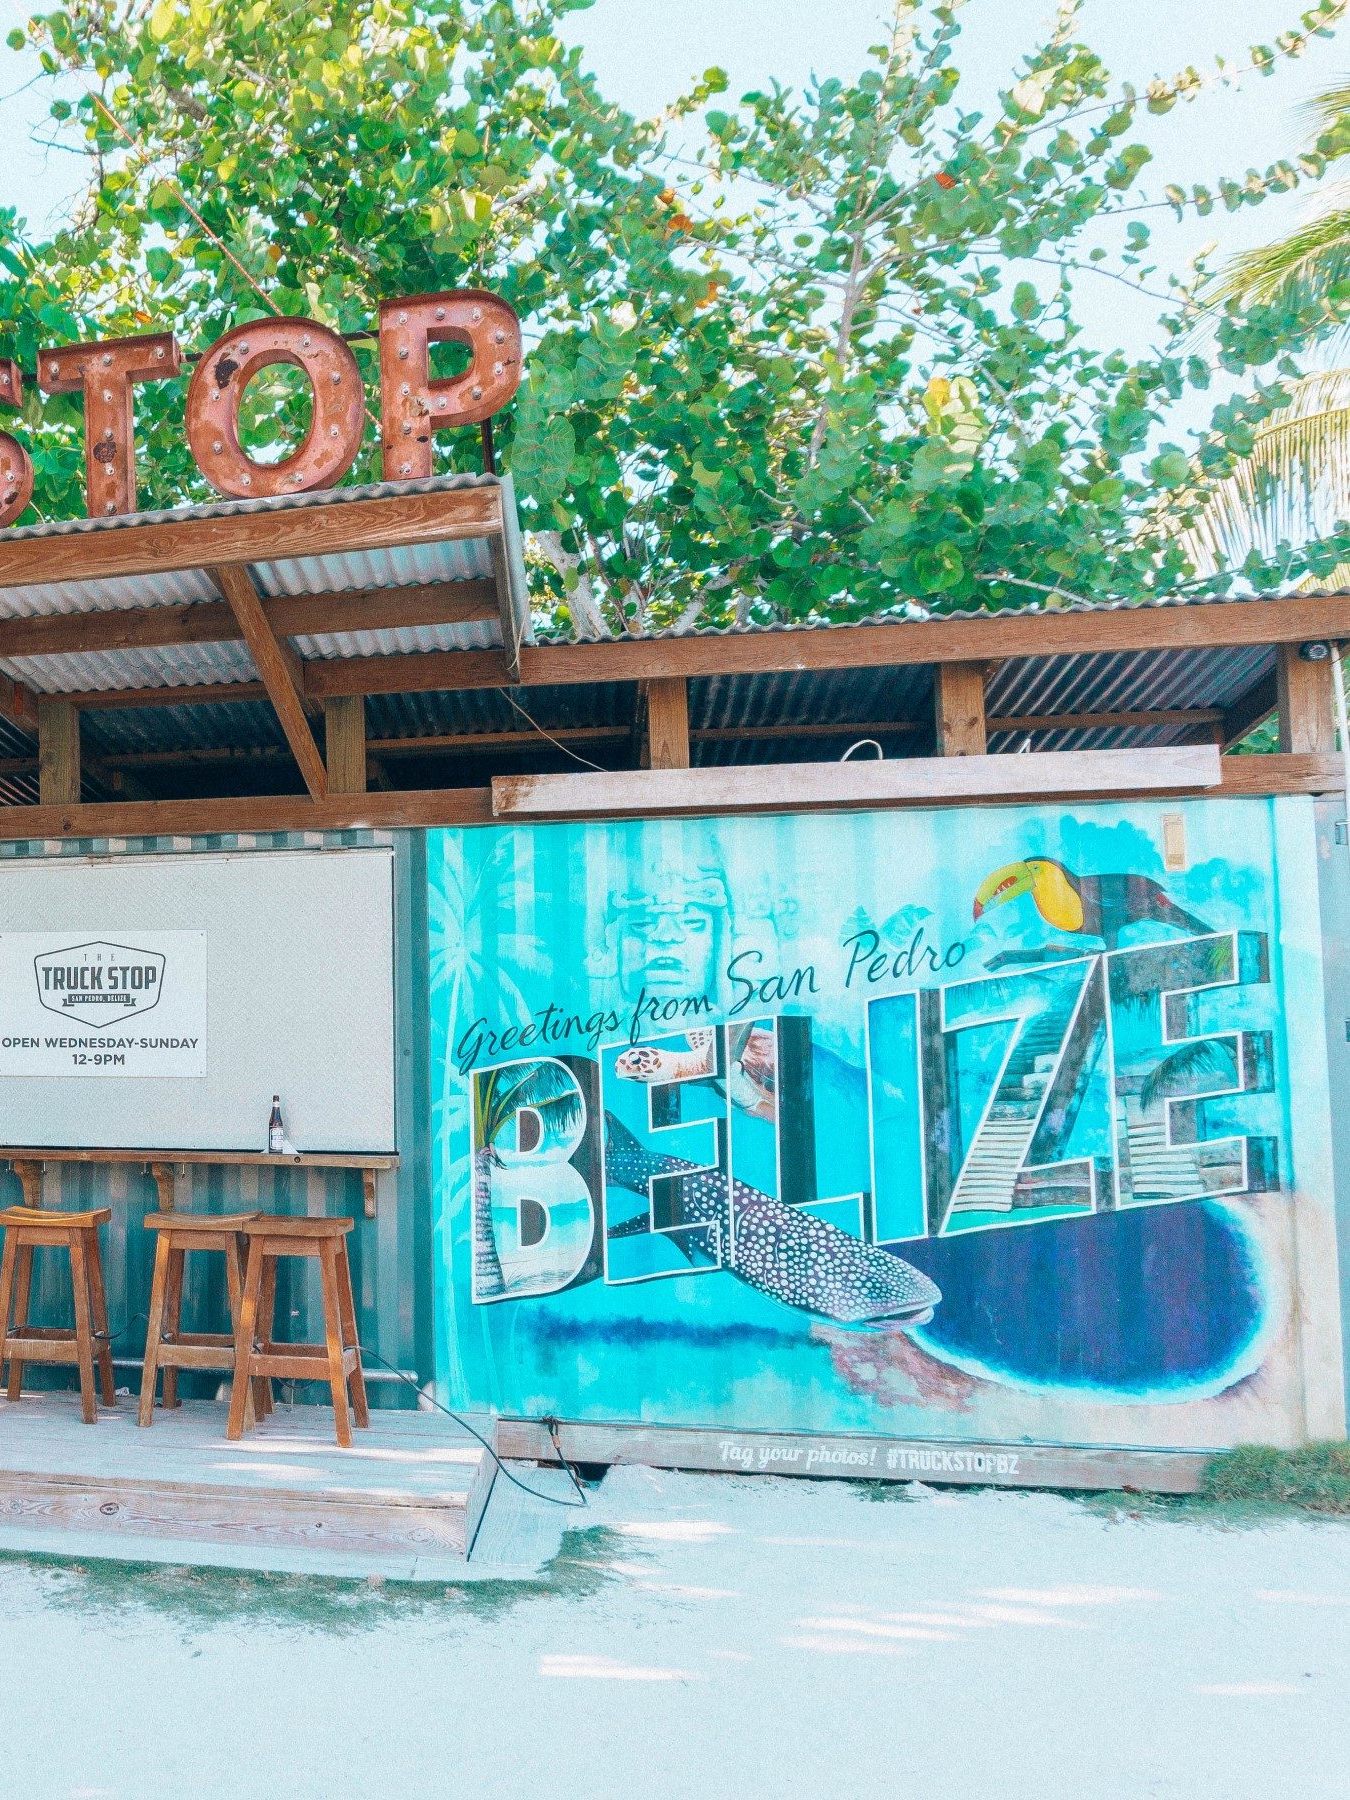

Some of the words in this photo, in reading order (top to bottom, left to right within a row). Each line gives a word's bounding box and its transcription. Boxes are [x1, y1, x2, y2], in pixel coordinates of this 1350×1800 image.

[83, 953, 115, 962] THE
[42, 966, 103, 990] TRUCK
[108, 965, 157, 990] STOP
[71, 994, 83, 1002] SAN
[107, 994, 127, 1002] BELIZE
[457, 1003, 624, 1076] Greetings
[629, 988, 712, 1046] from
[726, 950, 821, 1016] San
[842, 927, 966, 989] Pedro
[1, 1037, 40, 1048] OPEN
[44, 1037, 199, 1049] WEDNESDAY-SUNDAY
[72, 1053, 125, 1065] 12-9PM
[469, 930, 1282, 1304] BELIZE
[719, 1441, 753, 1468] Tag
[757, 1446, 803, 1469] your
[806, 1447, 876, 1470] photos!
[886, 1449, 1020, 1475] #TRUCKSTOPBZ
